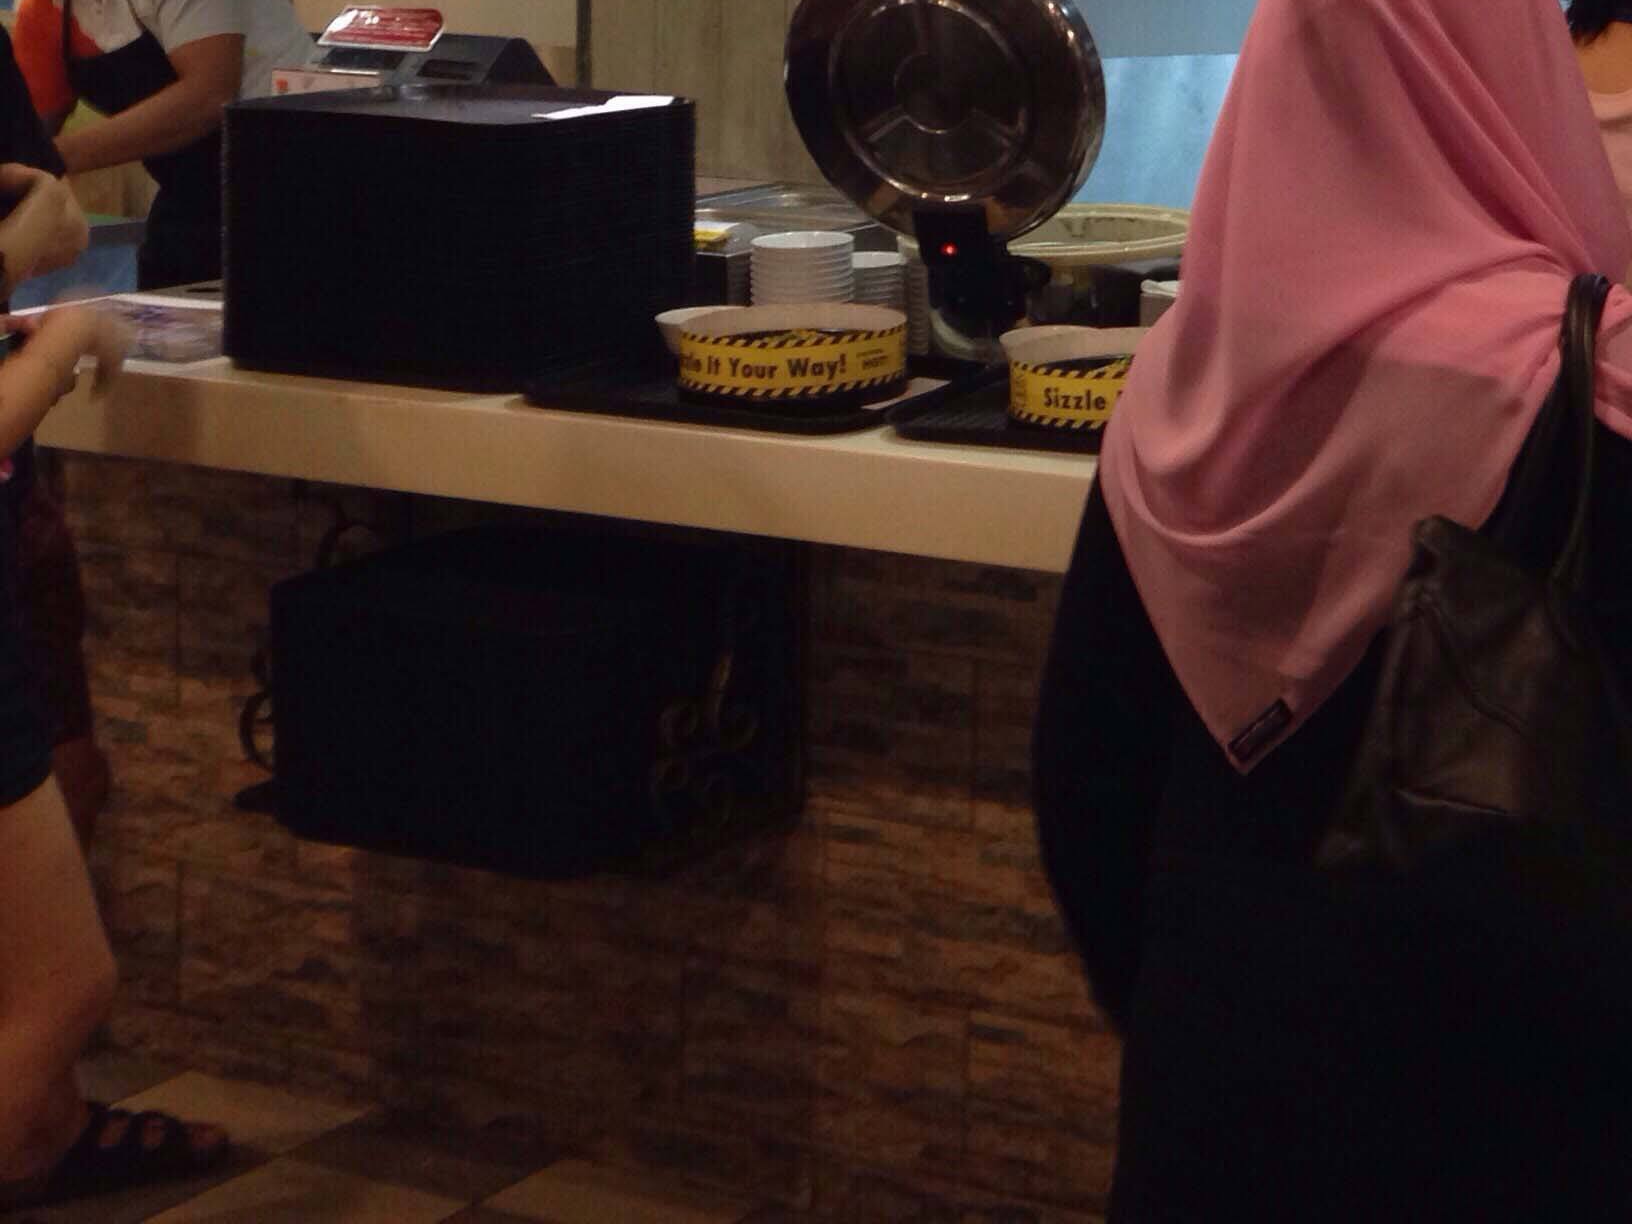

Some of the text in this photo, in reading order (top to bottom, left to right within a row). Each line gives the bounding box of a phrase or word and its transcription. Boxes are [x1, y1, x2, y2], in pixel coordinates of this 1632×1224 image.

[706, 355, 720, 375] It
[728, 357, 778, 379] Your
[786, 353, 848, 381] Way!
[1043, 387, 1107, 411] Sizzle
